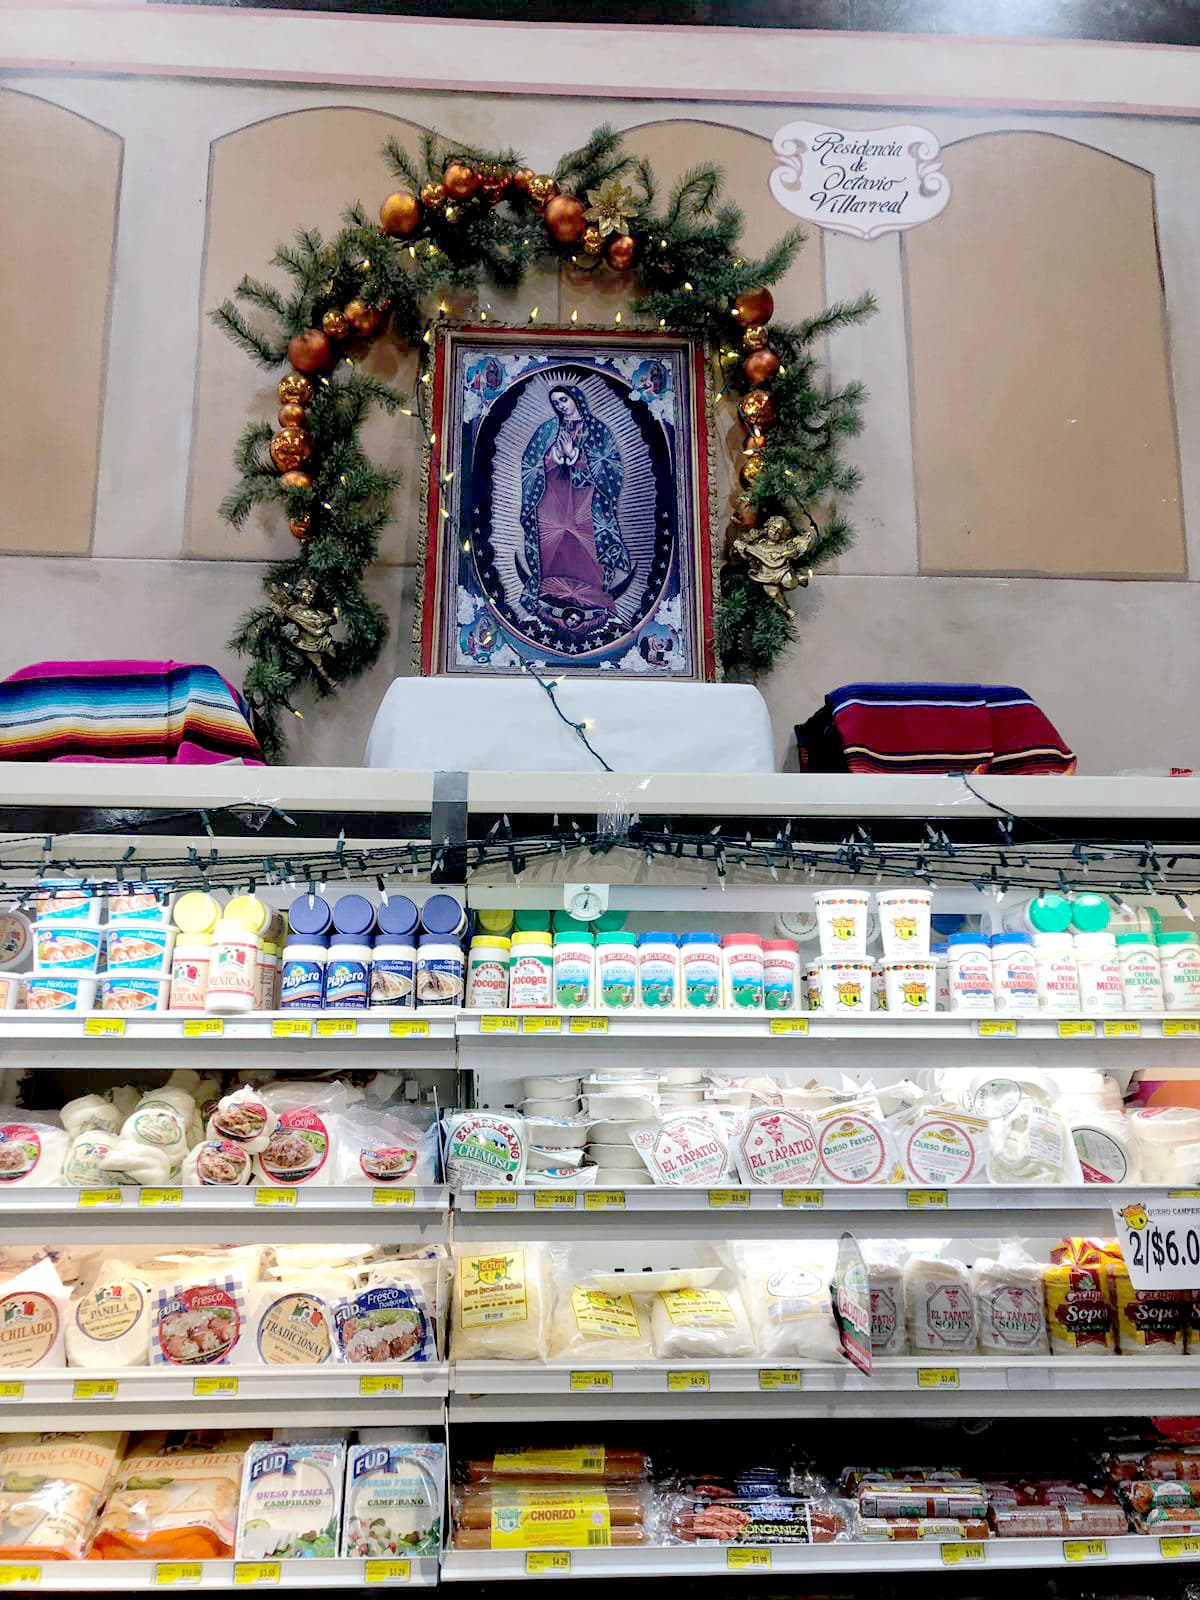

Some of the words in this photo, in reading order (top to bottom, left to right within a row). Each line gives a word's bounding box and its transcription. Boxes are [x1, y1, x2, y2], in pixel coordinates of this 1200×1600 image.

[812, 132, 902, 166] Residencia
[850, 157, 868, 172] de
[823, 165, 906, 191] Octavio
[810, 191, 908, 214] Villarreal
[283, 972, 320, 988] Playero
[327, 972, 364, 988] Playero
[290, 1116, 315, 1129] Cotija
[458, 1144, 511, 1171] CREMOSO
[661, 1160, 677, 1174] EL
[676, 1142, 718, 1167] TAPATIO
[750, 1153, 766, 1169] EL
[766, 1138, 814, 1162] TAPATIO
[191, 1292, 224, 1307] Fresco
[367, 1290, 399, 1305] Fresco
[91, 1303, 129, 1320] PANELA
[931, 1311, 941, 1321] EL
[944, 1311, 972, 1321] TAPATIO
[994, 1310, 1005, 1321] EL
[1008, 1311, 1041, 1322] TAPATIO
[265, 1319, 324, 1357] TRADICIONAL
[253, 1454, 286, 1478] FUD
[355, 1449, 389, 1475] FUD
[256, 1489, 290, 1501] QUESO
[292, 1487, 334, 1498] PANELA
[531, 1508, 576, 1521] CHORIZO
[739, 1523, 808, 1536] LONGANIZA
[552, 1556, 569, 1566] $4.29
